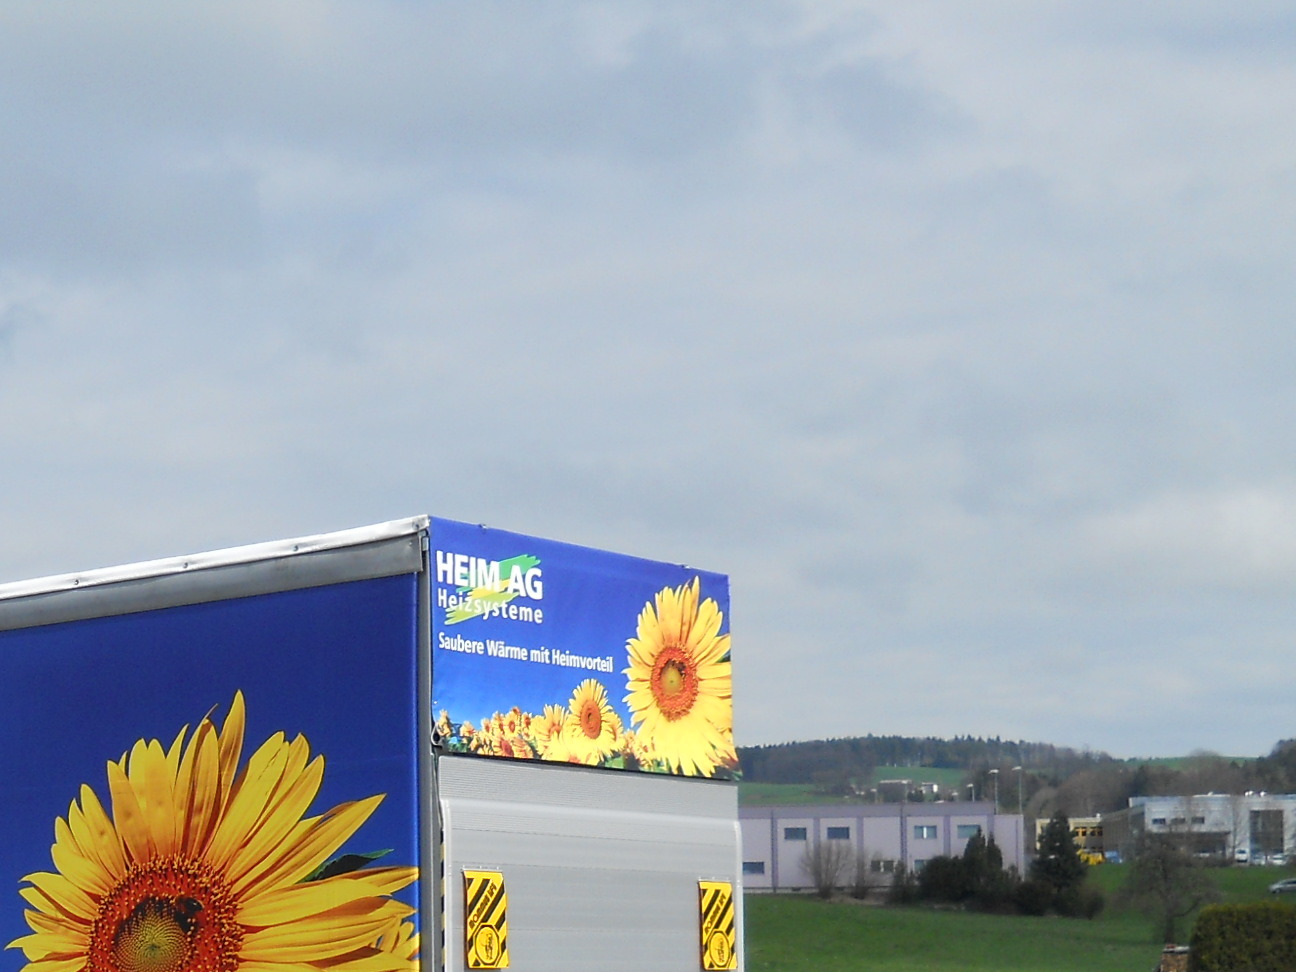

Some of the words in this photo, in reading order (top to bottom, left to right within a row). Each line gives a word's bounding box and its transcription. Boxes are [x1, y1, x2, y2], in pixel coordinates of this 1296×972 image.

[436, 550, 500, 592] HEIM
[507, 564, 543, 600] AG
[437, 587, 543, 624] Heizsysteme
[438, 631, 485, 654] Saubere
[486, 639, 528, 661] Wärme
[530, 646, 551, 664] mit
[551, 648, 614, 673] Heimvorteil
